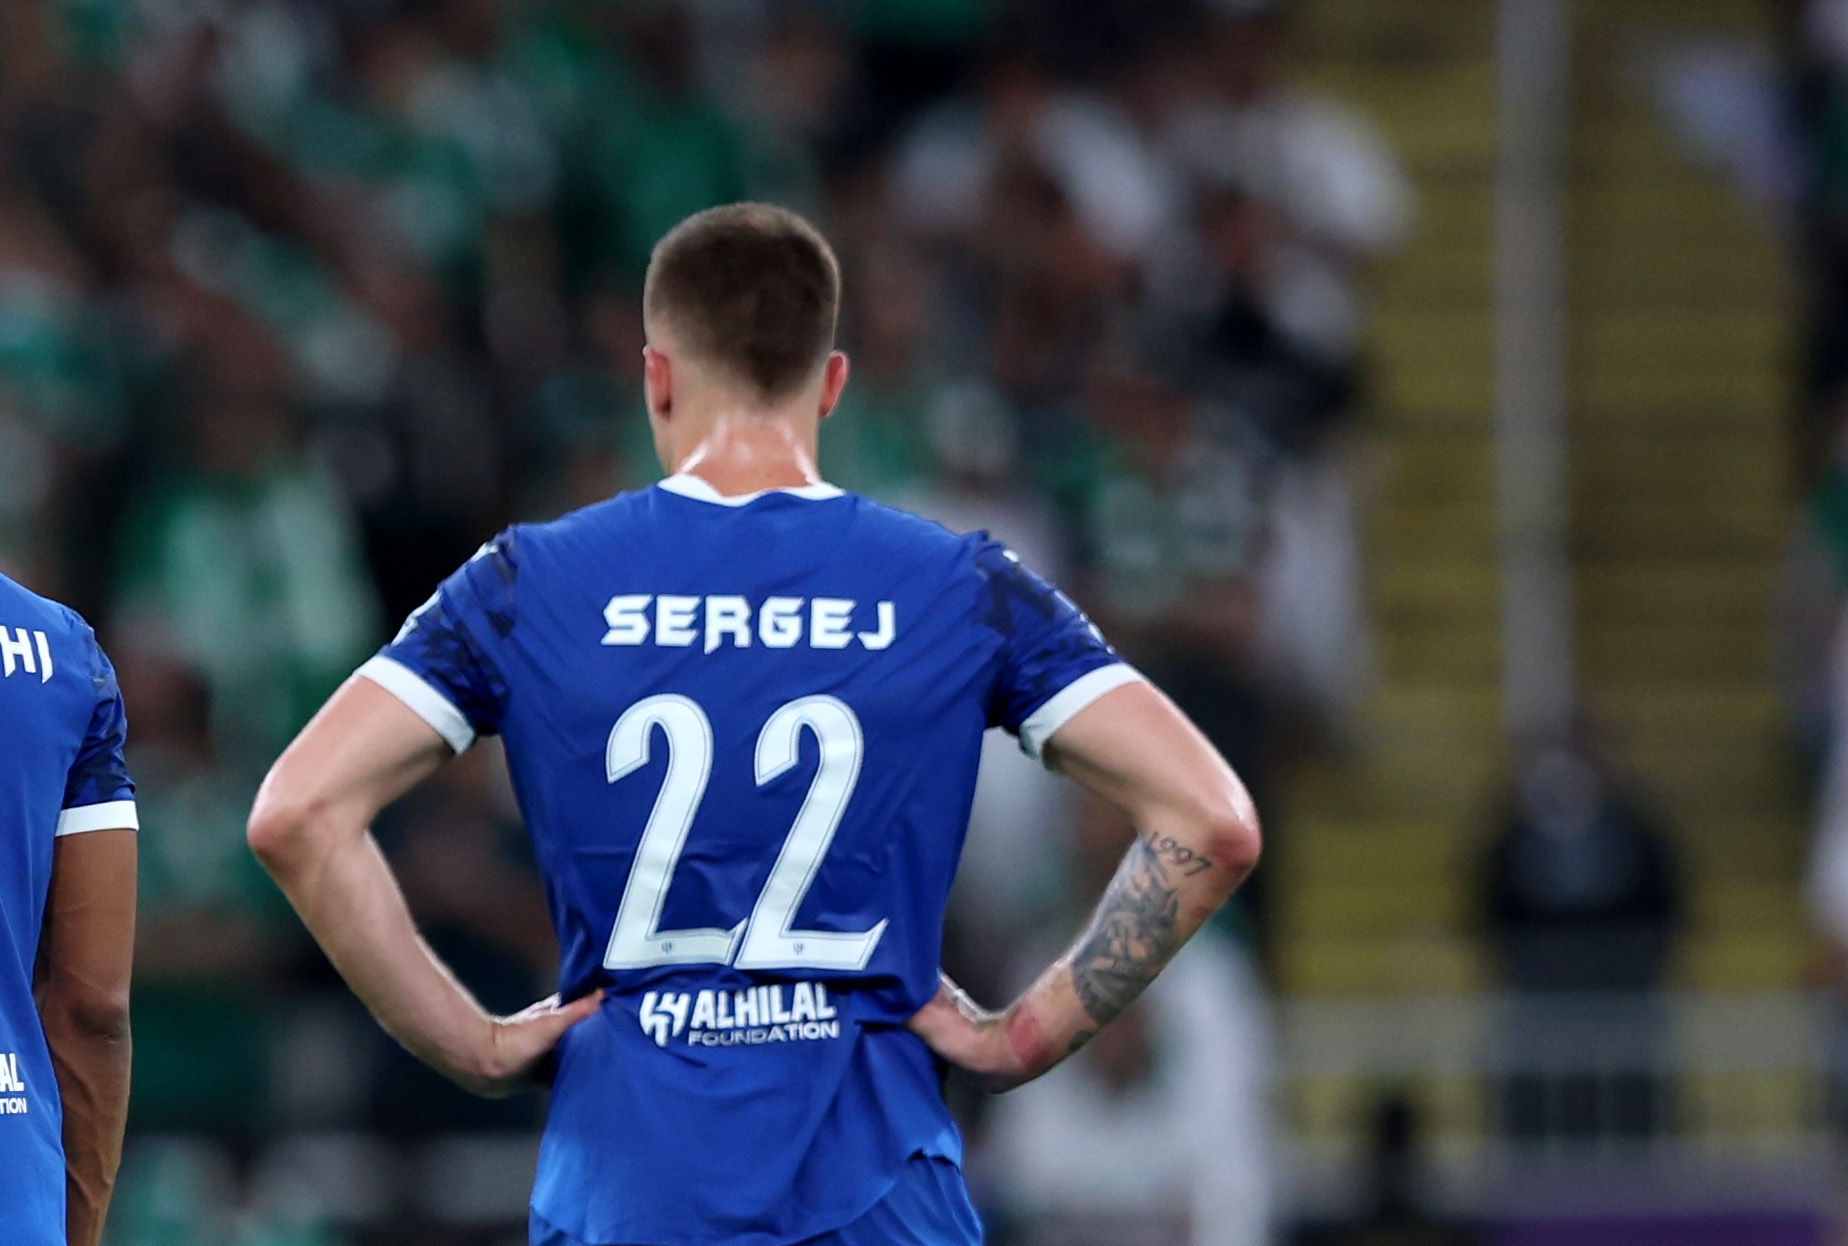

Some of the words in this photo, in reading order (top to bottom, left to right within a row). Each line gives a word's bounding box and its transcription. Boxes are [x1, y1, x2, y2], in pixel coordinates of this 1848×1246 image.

[601, 595, 896, 655] SERGEJ
[603, 693, 889, 970] 22
[688, 1020, 840, 1046] FOUNDATION
